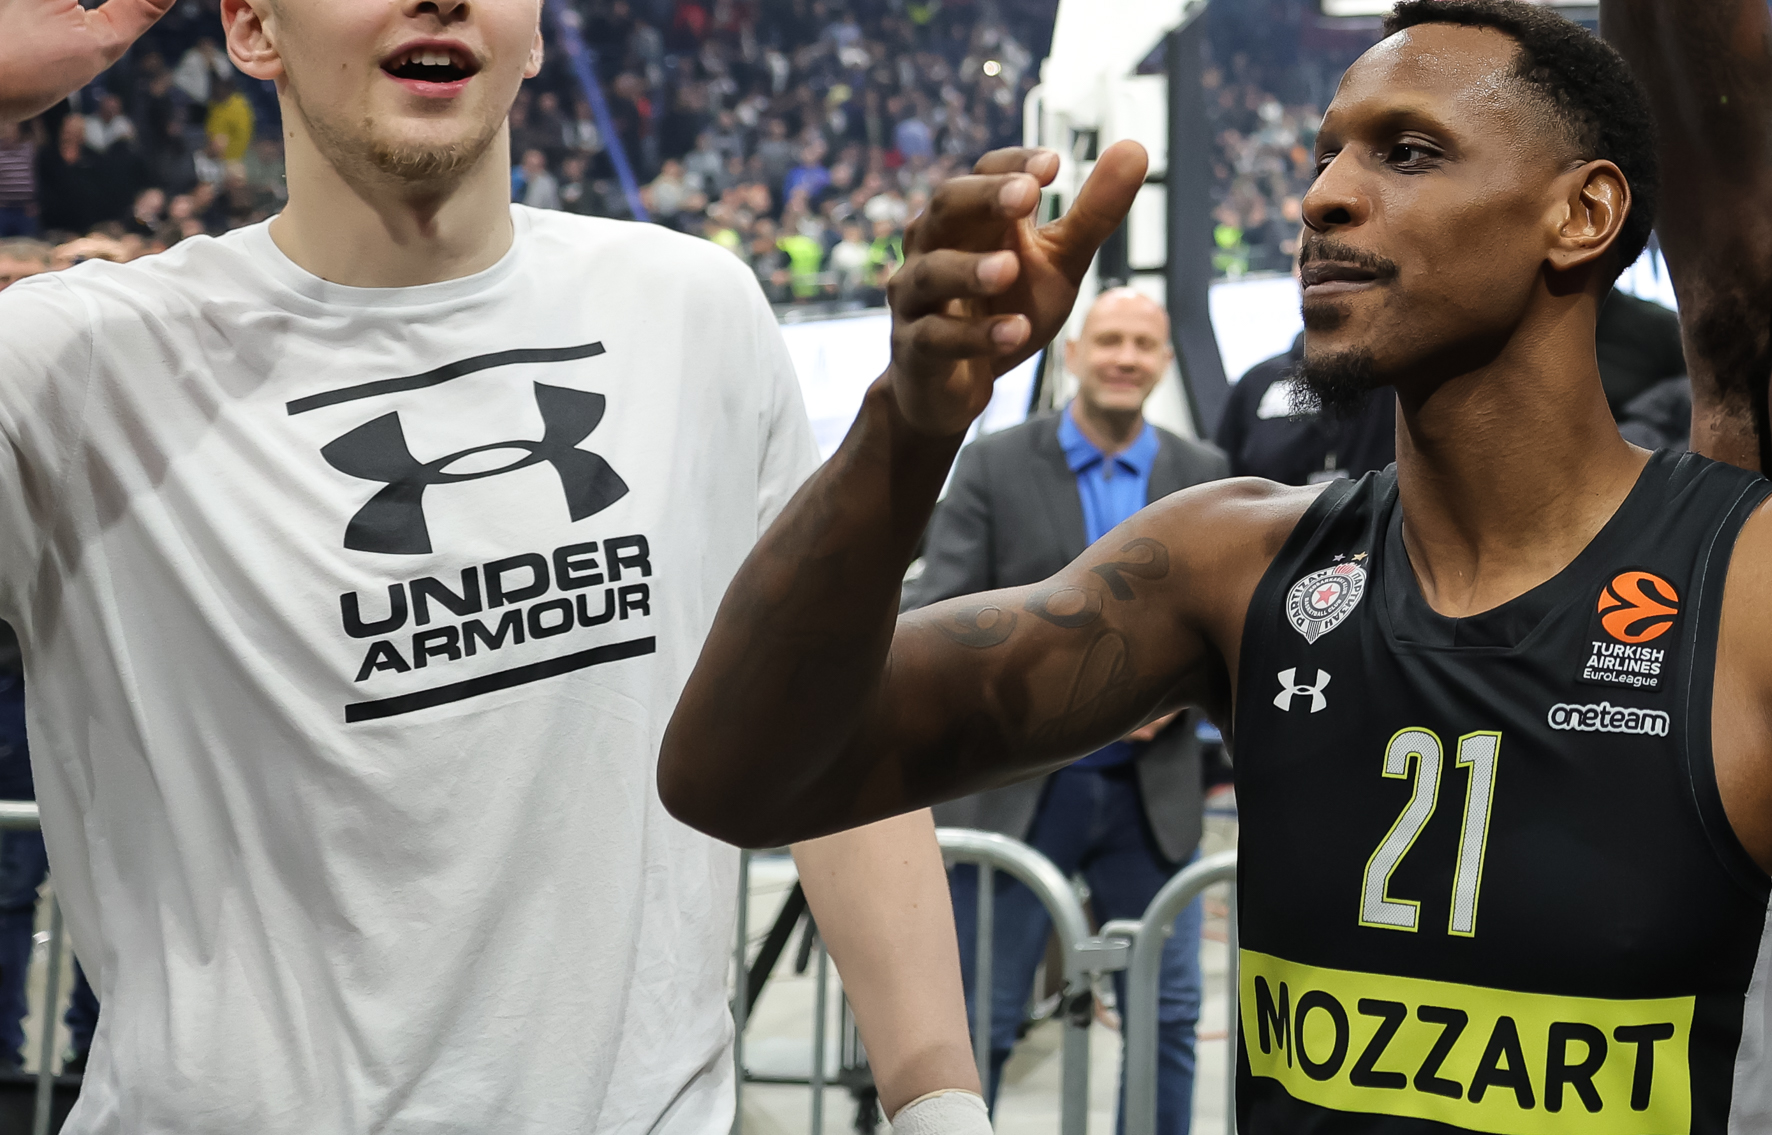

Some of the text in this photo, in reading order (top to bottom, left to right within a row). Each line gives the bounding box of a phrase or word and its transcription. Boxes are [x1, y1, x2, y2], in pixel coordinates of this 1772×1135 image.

[340, 534, 652, 639] UNDER
[1290, 570, 1328, 628] PARTIZAN
[354, 583, 651, 683] ARMOUR
[1592, 641, 1665, 662] TURKISH
[1583, 668, 1658, 687] EuroLeague
[1586, 655, 1661, 675] AIRLINES
[1549, 702, 1669, 736] oneteam
[1358, 725, 1502, 938] 21
[1254, 975, 1676, 1114] MOZZART
